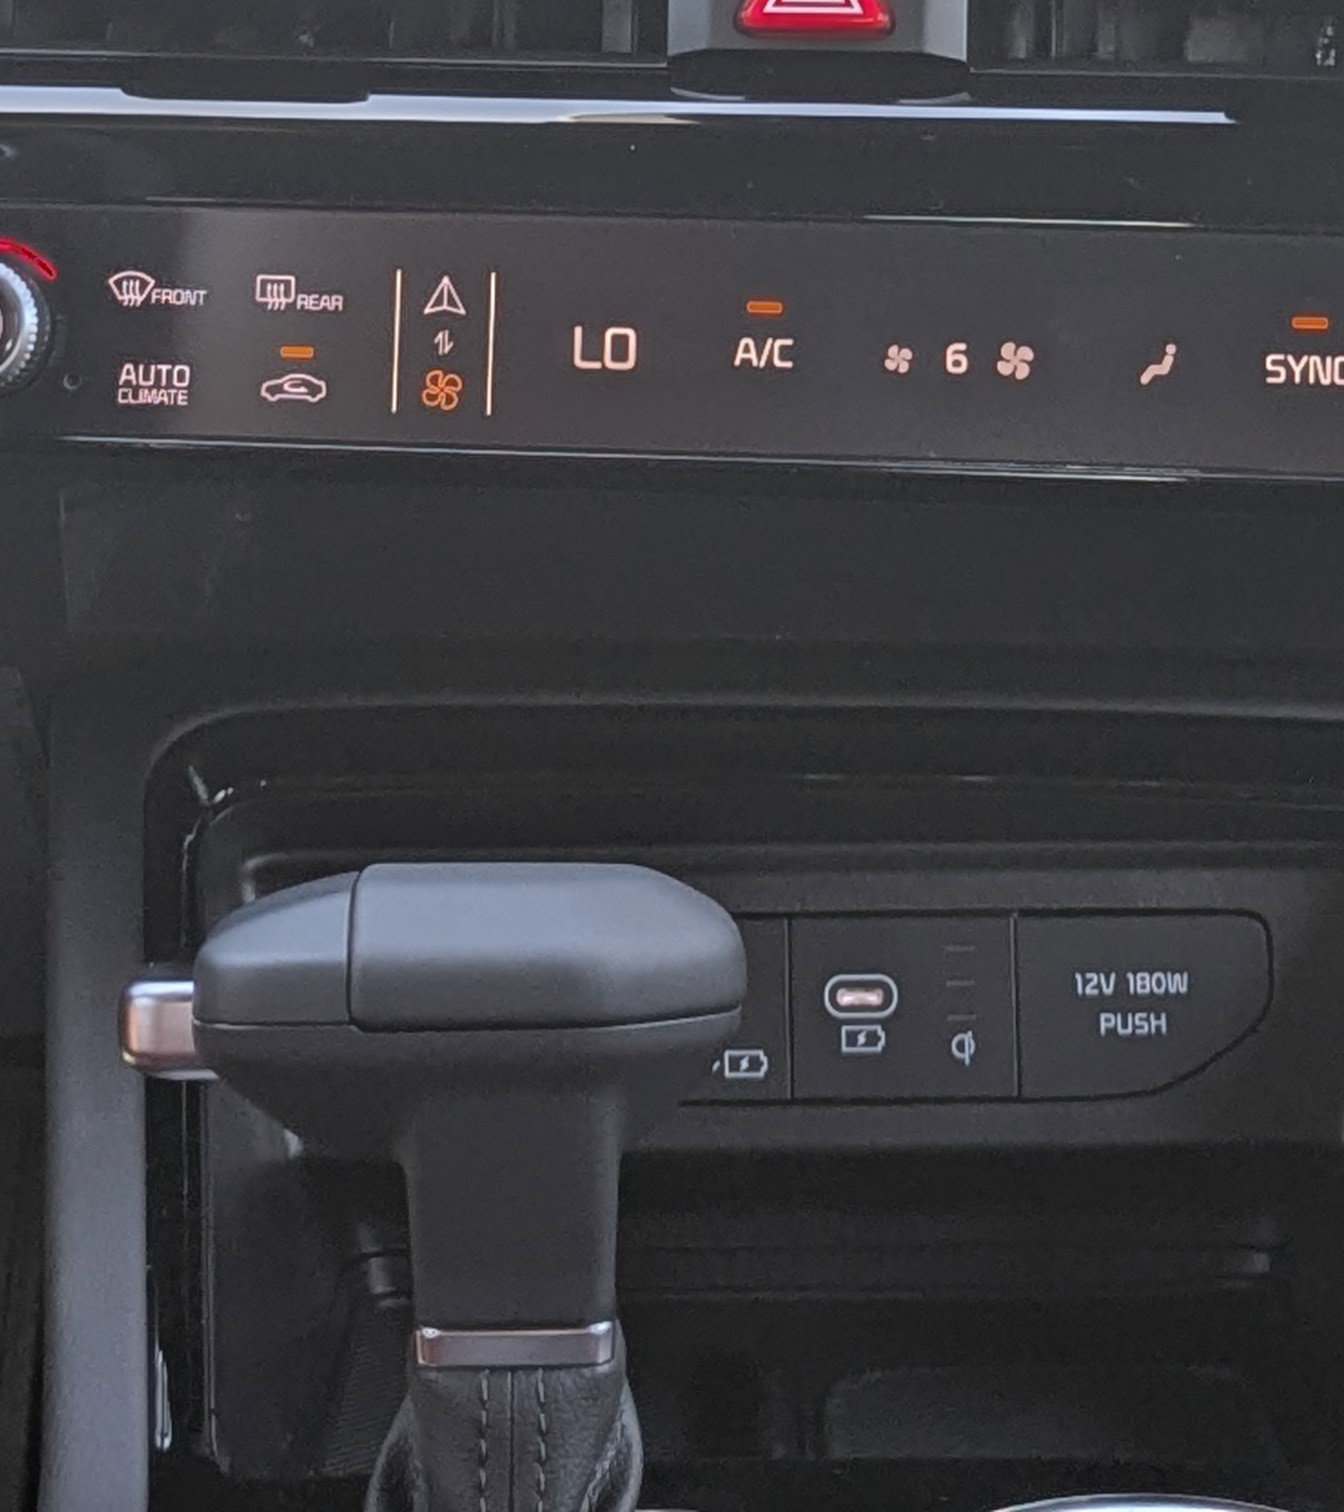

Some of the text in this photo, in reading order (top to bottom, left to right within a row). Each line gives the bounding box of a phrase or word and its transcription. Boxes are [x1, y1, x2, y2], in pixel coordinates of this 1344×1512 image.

[151, 288, 207, 306] FRONT
[296, 293, 344, 311] REAR
[574, 326, 636, 369] LO
[735, 338, 793, 367] A/C
[946, 343, 967, 373] 6
[119, 364, 190, 387] AUTO
[118, 386, 188, 405] CLIMATE
[1075, 970, 1189, 996] 12V 180W
[1100, 1011, 1167, 1037] PUSH
